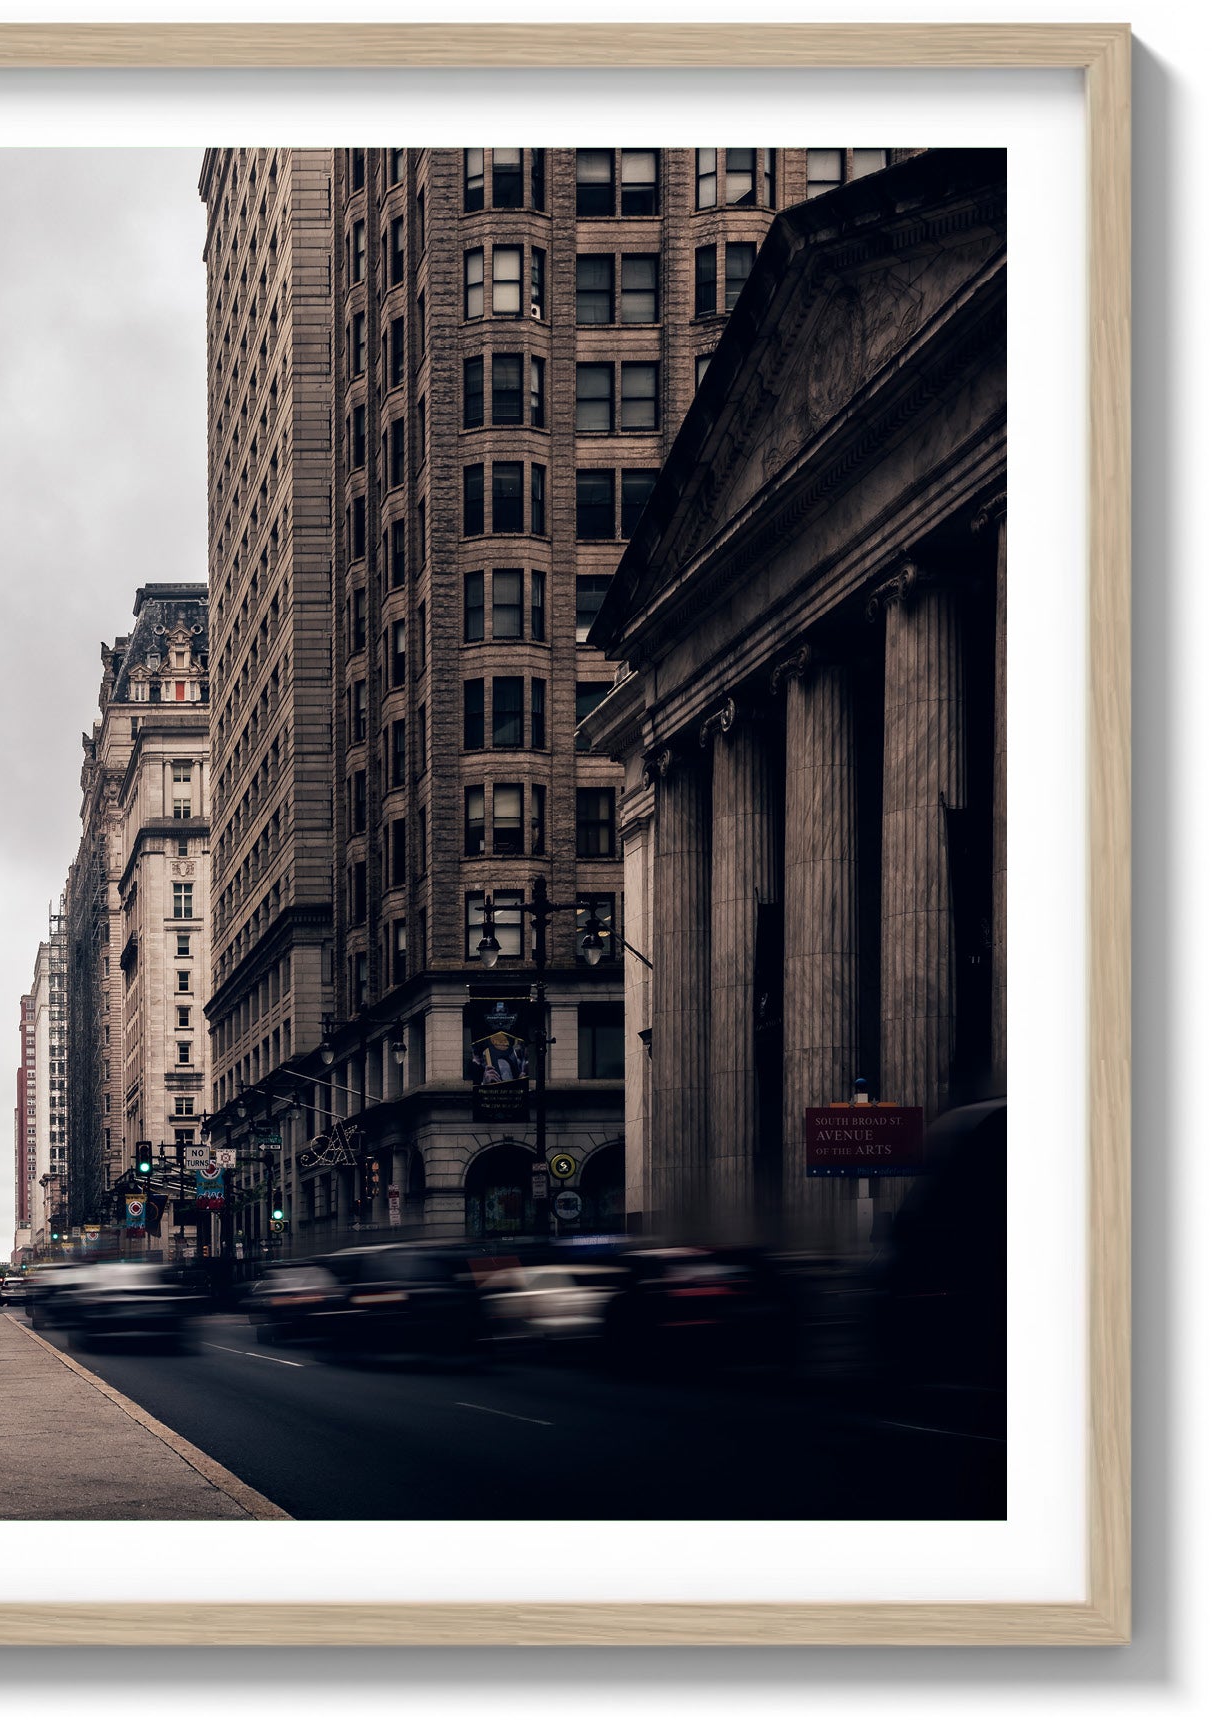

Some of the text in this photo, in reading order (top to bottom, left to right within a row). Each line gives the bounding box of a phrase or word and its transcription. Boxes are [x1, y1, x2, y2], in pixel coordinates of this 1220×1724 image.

[814, 1117, 849, 1126] SOUTH
[852, 1117, 887, 1126] BROAD
[816, 1129, 874, 1141] AVENUE
[191, 1149, 204, 1157] NO
[815, 1144, 893, 1155] OF THE ARTS
